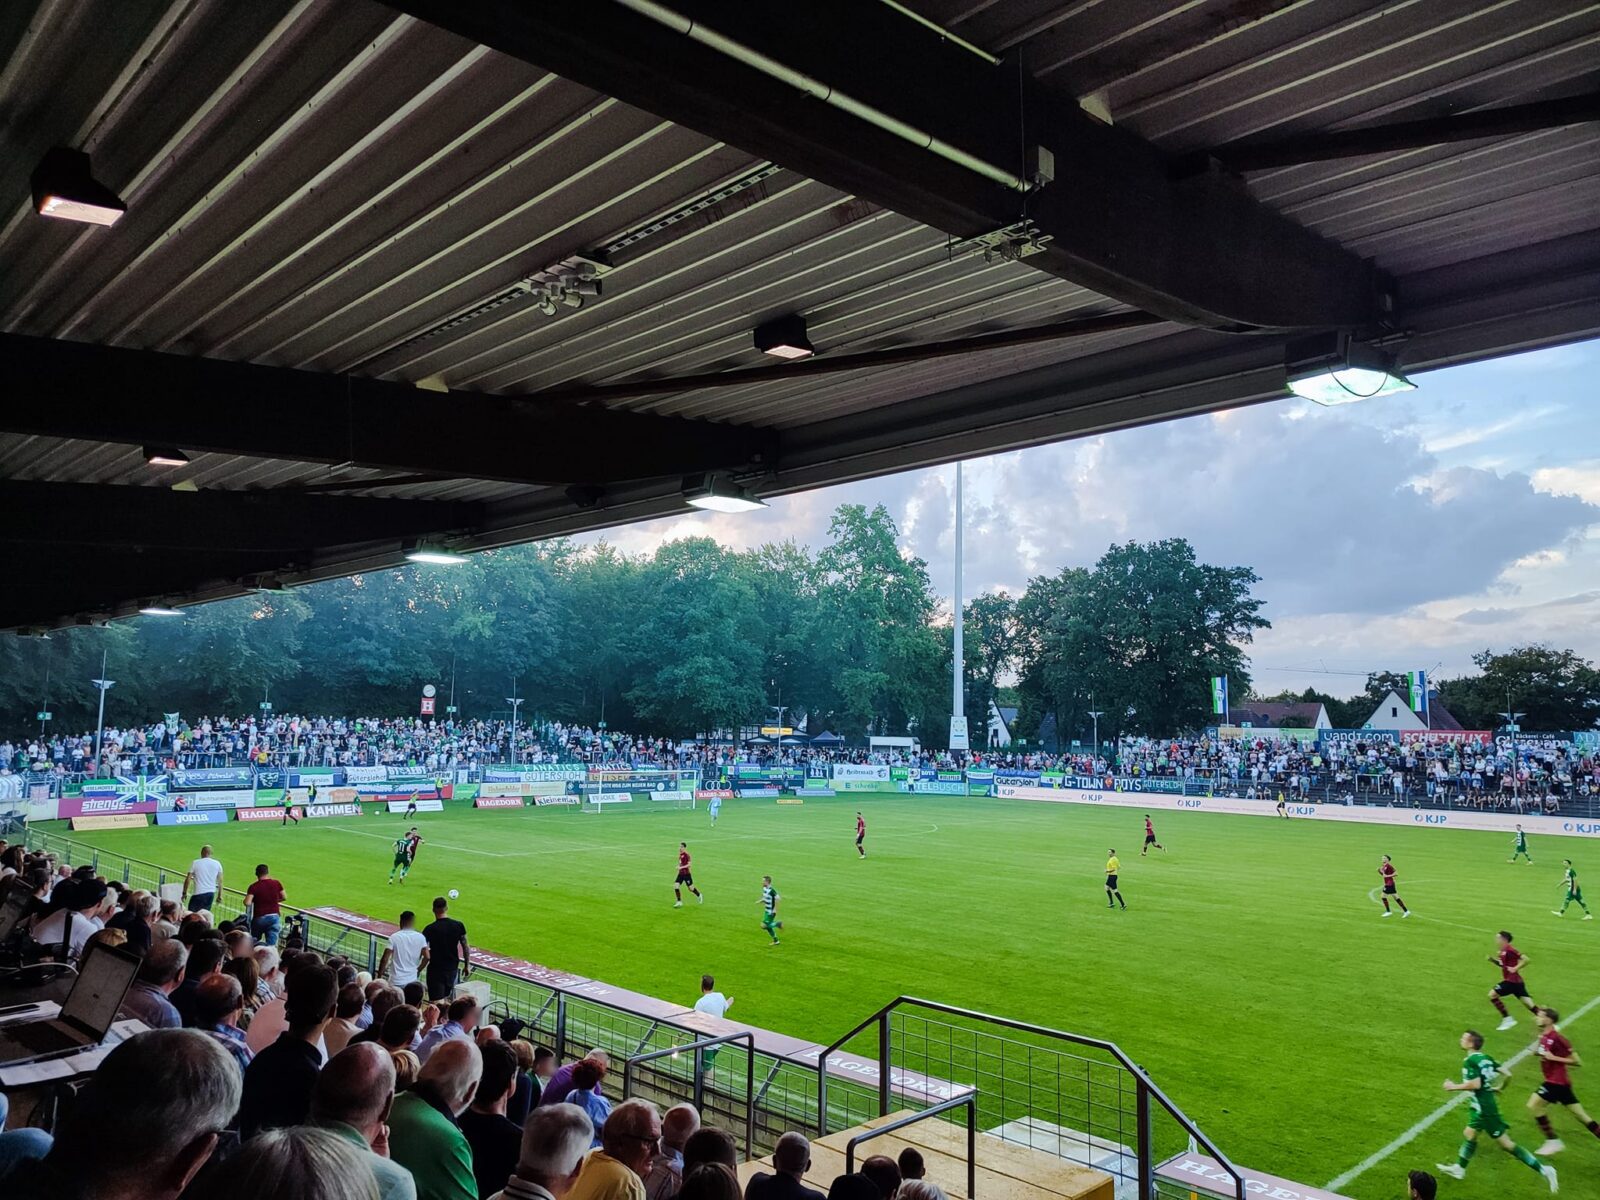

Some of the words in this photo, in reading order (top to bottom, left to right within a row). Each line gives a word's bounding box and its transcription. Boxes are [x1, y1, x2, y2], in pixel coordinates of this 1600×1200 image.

[524, 764, 580, 772] FANATICS
[1064, 776, 1103, 789] G-TOWN
[1088, 794, 1103, 802] KJP
[478, 799, 522, 807] HAGEDORN
[1185, 800, 1202, 808] KJP
[241, 809, 300, 819] HAGEDON
[1296, 807, 1316, 815] KJP
[1425, 814, 1447, 824] KJP
[1576, 823, 1600, 833] KJP
